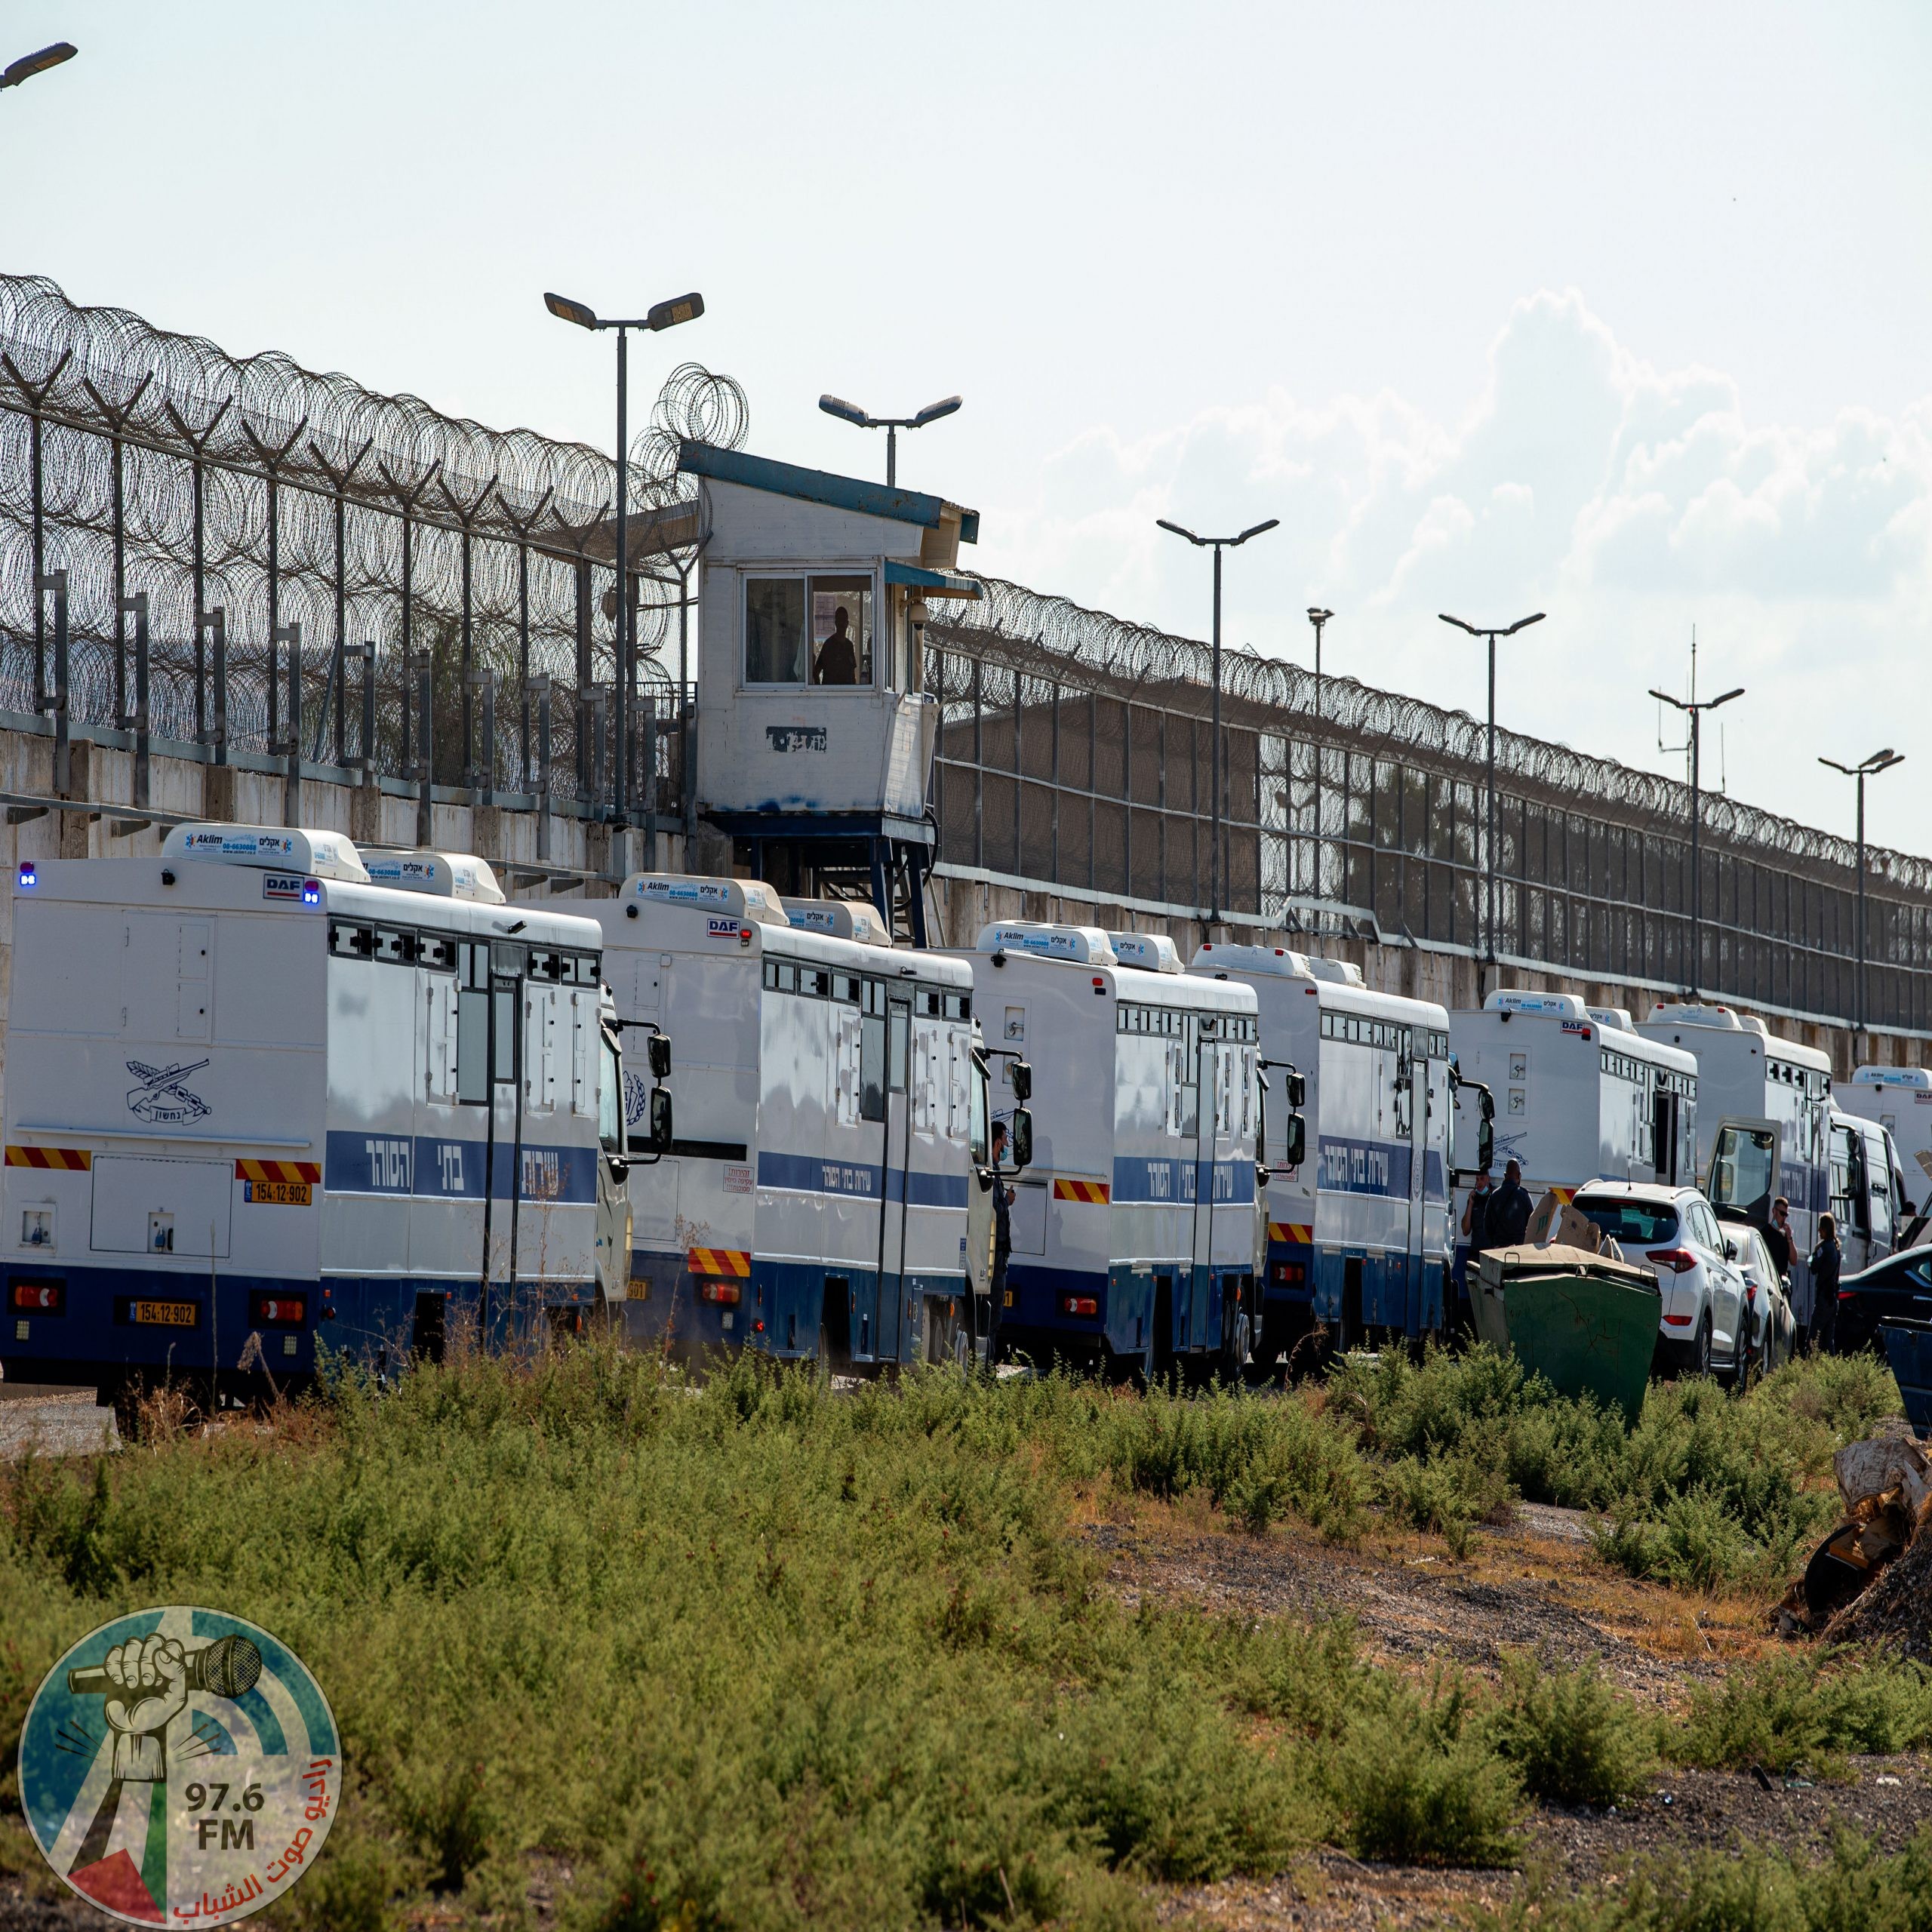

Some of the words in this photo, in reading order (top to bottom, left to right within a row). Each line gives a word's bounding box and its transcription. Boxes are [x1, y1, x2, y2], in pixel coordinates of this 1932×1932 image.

[197, 834, 223, 844] Aklim
[260, 836, 280, 848] אקלים
[403, 862, 423, 874] אקלים
[266, 878, 300, 891] DAF
[648, 881, 669, 891] Aklim
[700, 884, 718, 896] אקלים
[807, 912, 824, 921] אקלים
[709, 921, 738, 931] DAF
[1004, 932, 1024, 940] Aklim
[1051, 936, 1067, 945] אקלים
[1120, 942, 1136, 950] אקלים
[1562, 1022, 1583, 1030] DAF
[155, 1110, 180, 1120] נחשון
[365, 1140, 411, 1188] הסוהר
[437, 1145, 465, 1191] בתי
[1324, 1145, 1348, 1182] הסוהר
[1351, 1148, 1365, 1184] בתי
[1367, 1150, 1389, 1186] שירות
[822, 1165, 840, 1189] הסוהר
[841, 1168, 854, 1190] בתי
[854, 1170, 871, 1192] שירות
[1147, 1162, 1171, 1198] הסוהר
[1182, 1164, 1195, 1198] בתי
[1212, 1164, 1233, 1199] שירות
